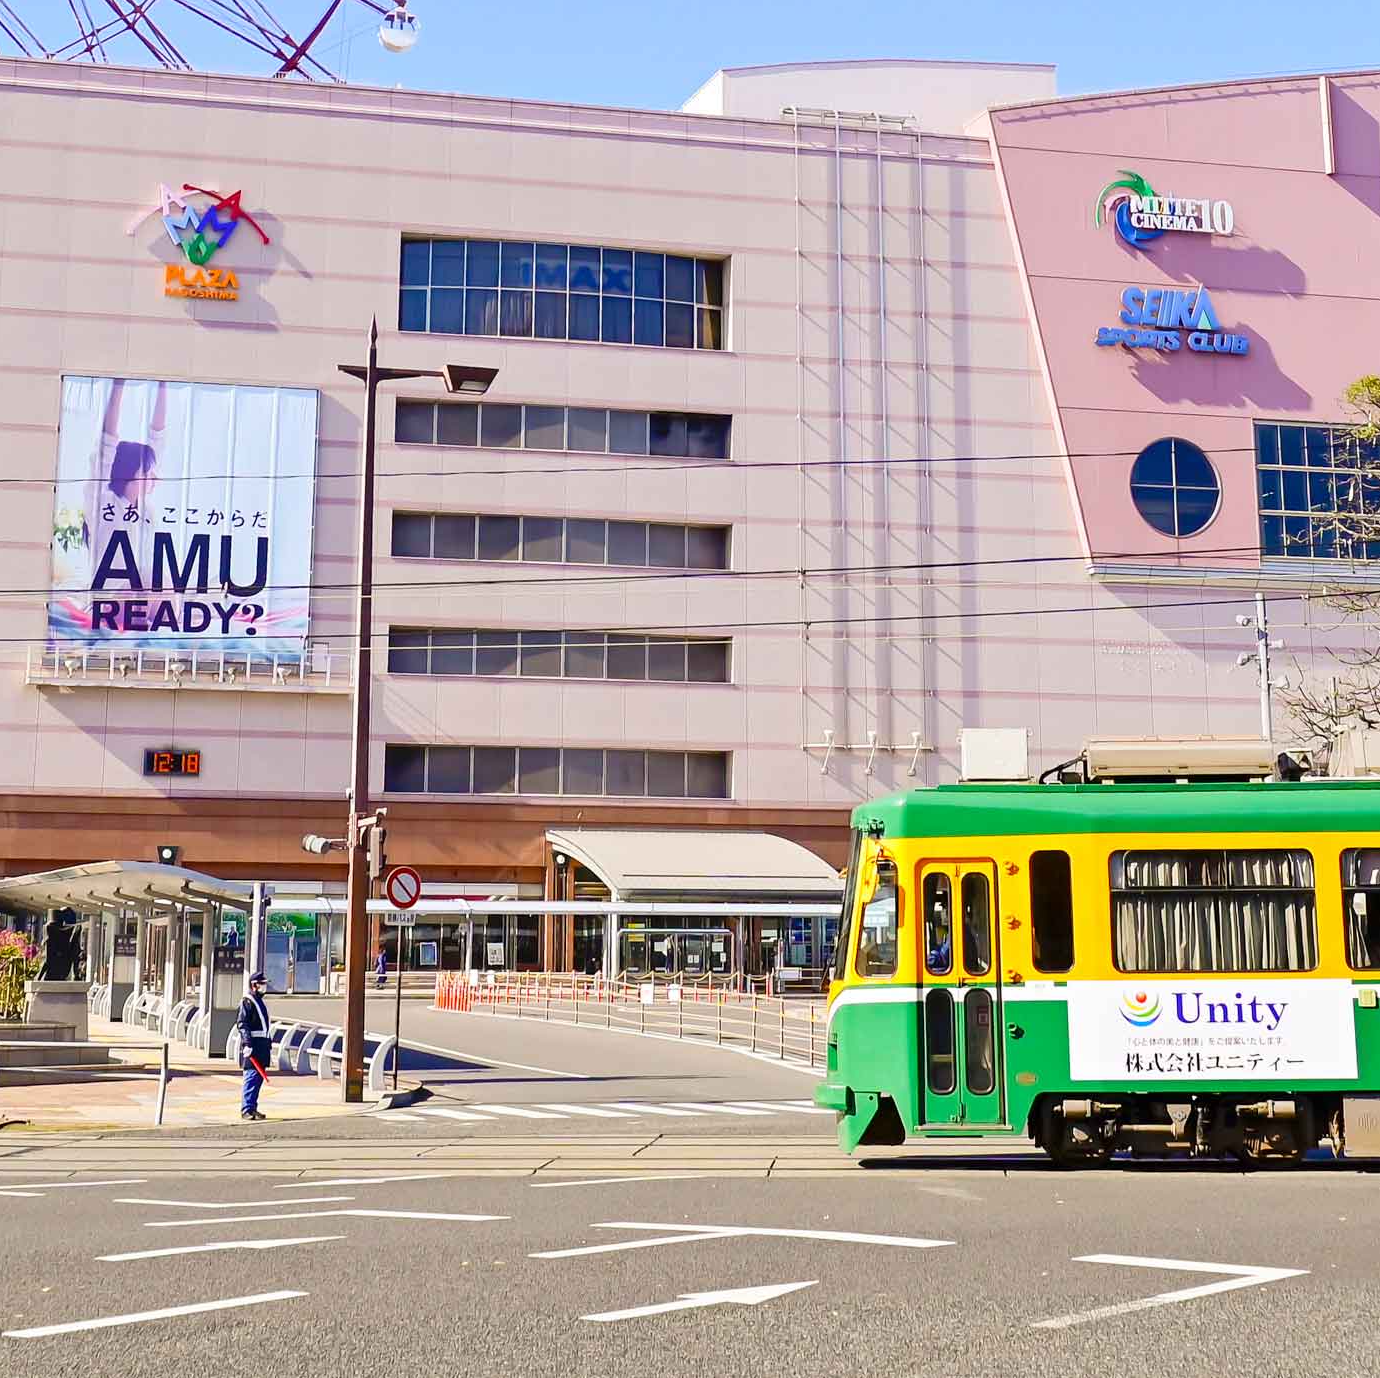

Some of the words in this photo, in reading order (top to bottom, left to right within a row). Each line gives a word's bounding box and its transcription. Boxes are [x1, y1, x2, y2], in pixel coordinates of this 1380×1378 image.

[1130, 213, 1199, 231] CINEMA
[1196, 199, 1234, 234] 10
[165, 265, 240, 289] PLAZA
[1119, 283, 1222, 331] SEIKA
[1094, 327, 1181, 351] SPORTS
[1187, 331, 1251, 356] CLUB
[91, 530, 269, 597] AMU
[91, 599, 264, 635] READY?
[153, 753, 199, 774] 12:18
[1172, 992, 1289, 1031] Unity
[1126, 1052, 1305, 1072] 株式会社ユニティー
